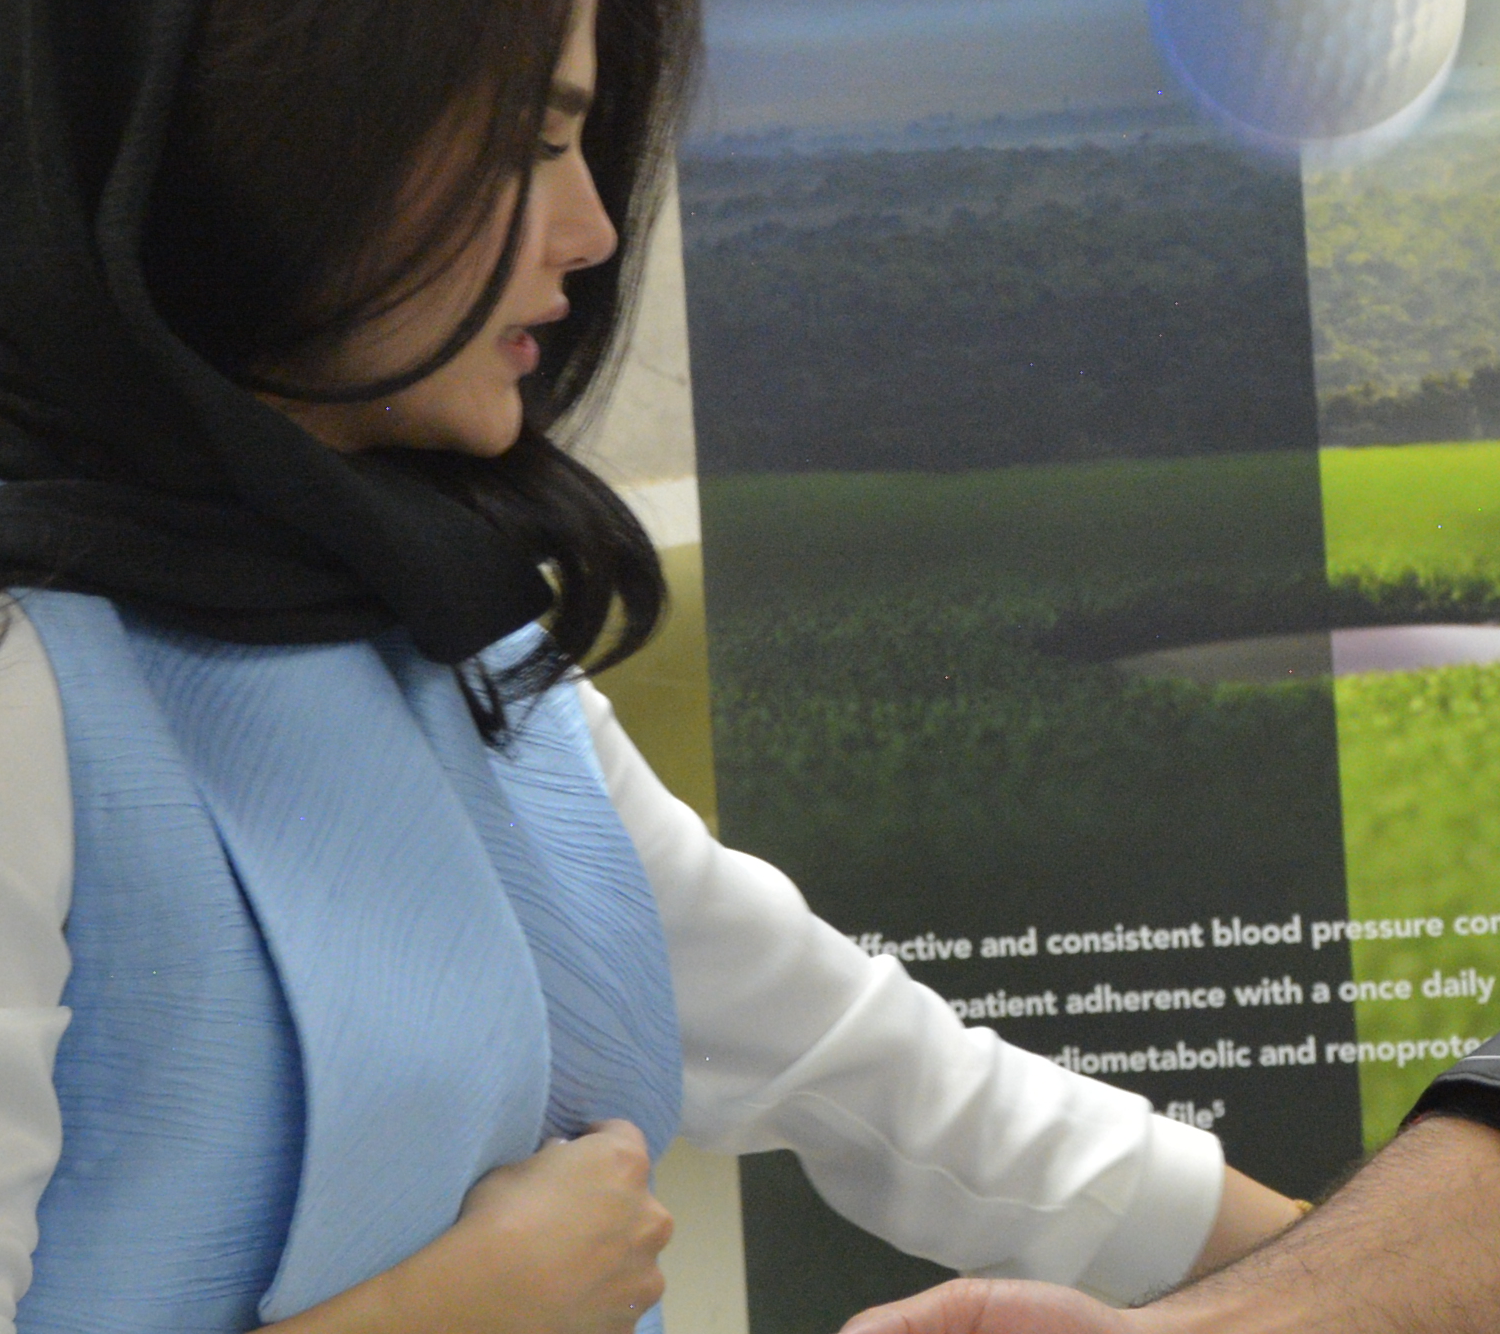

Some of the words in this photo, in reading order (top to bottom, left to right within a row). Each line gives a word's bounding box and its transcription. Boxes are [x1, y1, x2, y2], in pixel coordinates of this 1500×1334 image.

[848, 932, 972, 963] ffective
[980, 926, 1038, 959] and
[1045, 922, 1204, 956] consistent
[1212, 914, 1302, 948] blood
[1310, 915, 1444, 951] pressure
[951, 989, 1058, 1021] patient
[1065, 983, 1226, 1015] adherence
[1234, 975, 1303, 1007] with
[1310, 981, 1330, 1004] a
[1337, 976, 1414, 1002] once
[1421, 968, 1496, 1004] daily
[1258, 1034, 1318, 1067] and
[1325, 1035, 1488, 1065] renoprote
